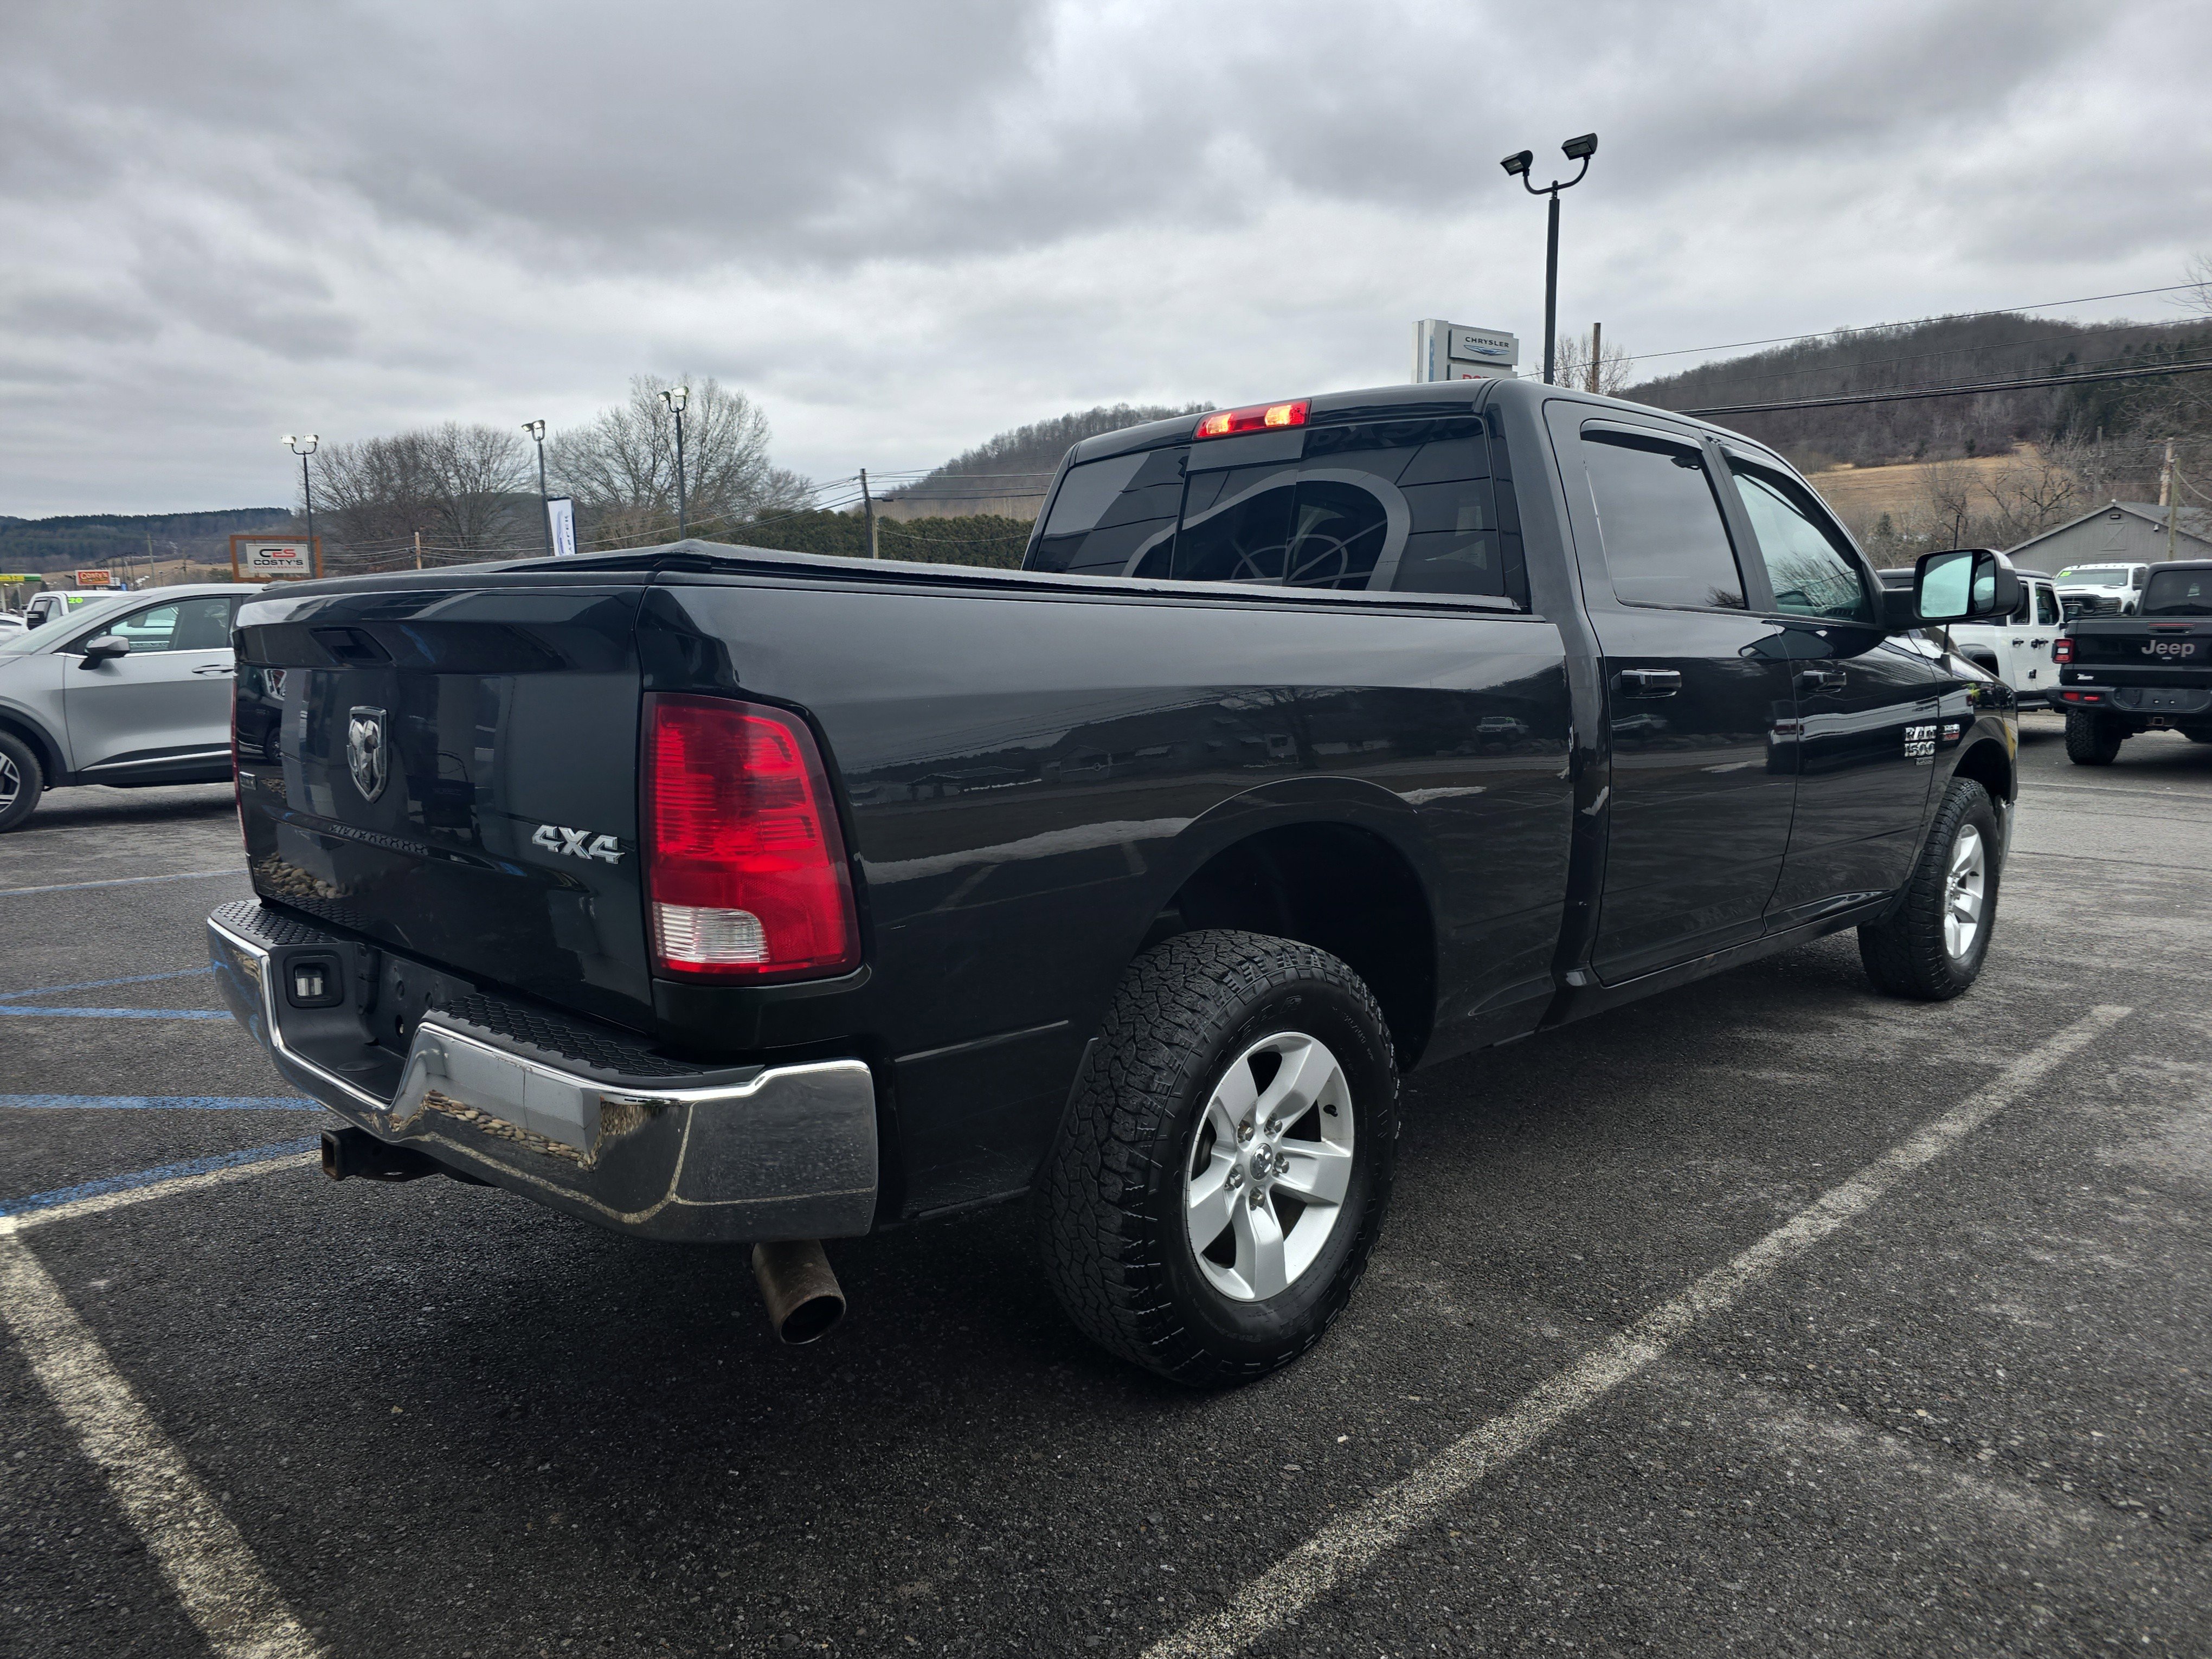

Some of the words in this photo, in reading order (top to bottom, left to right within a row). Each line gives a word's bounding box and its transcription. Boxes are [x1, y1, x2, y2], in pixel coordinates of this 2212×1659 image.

[1465, 337, 1509, 348] CHRYSLER
[2142, 640, 2195, 657] Jeep
[1905, 725, 1937, 741] RAM
[1904, 741, 1935, 757] 1500
[532, 825, 626, 864] 4X4
